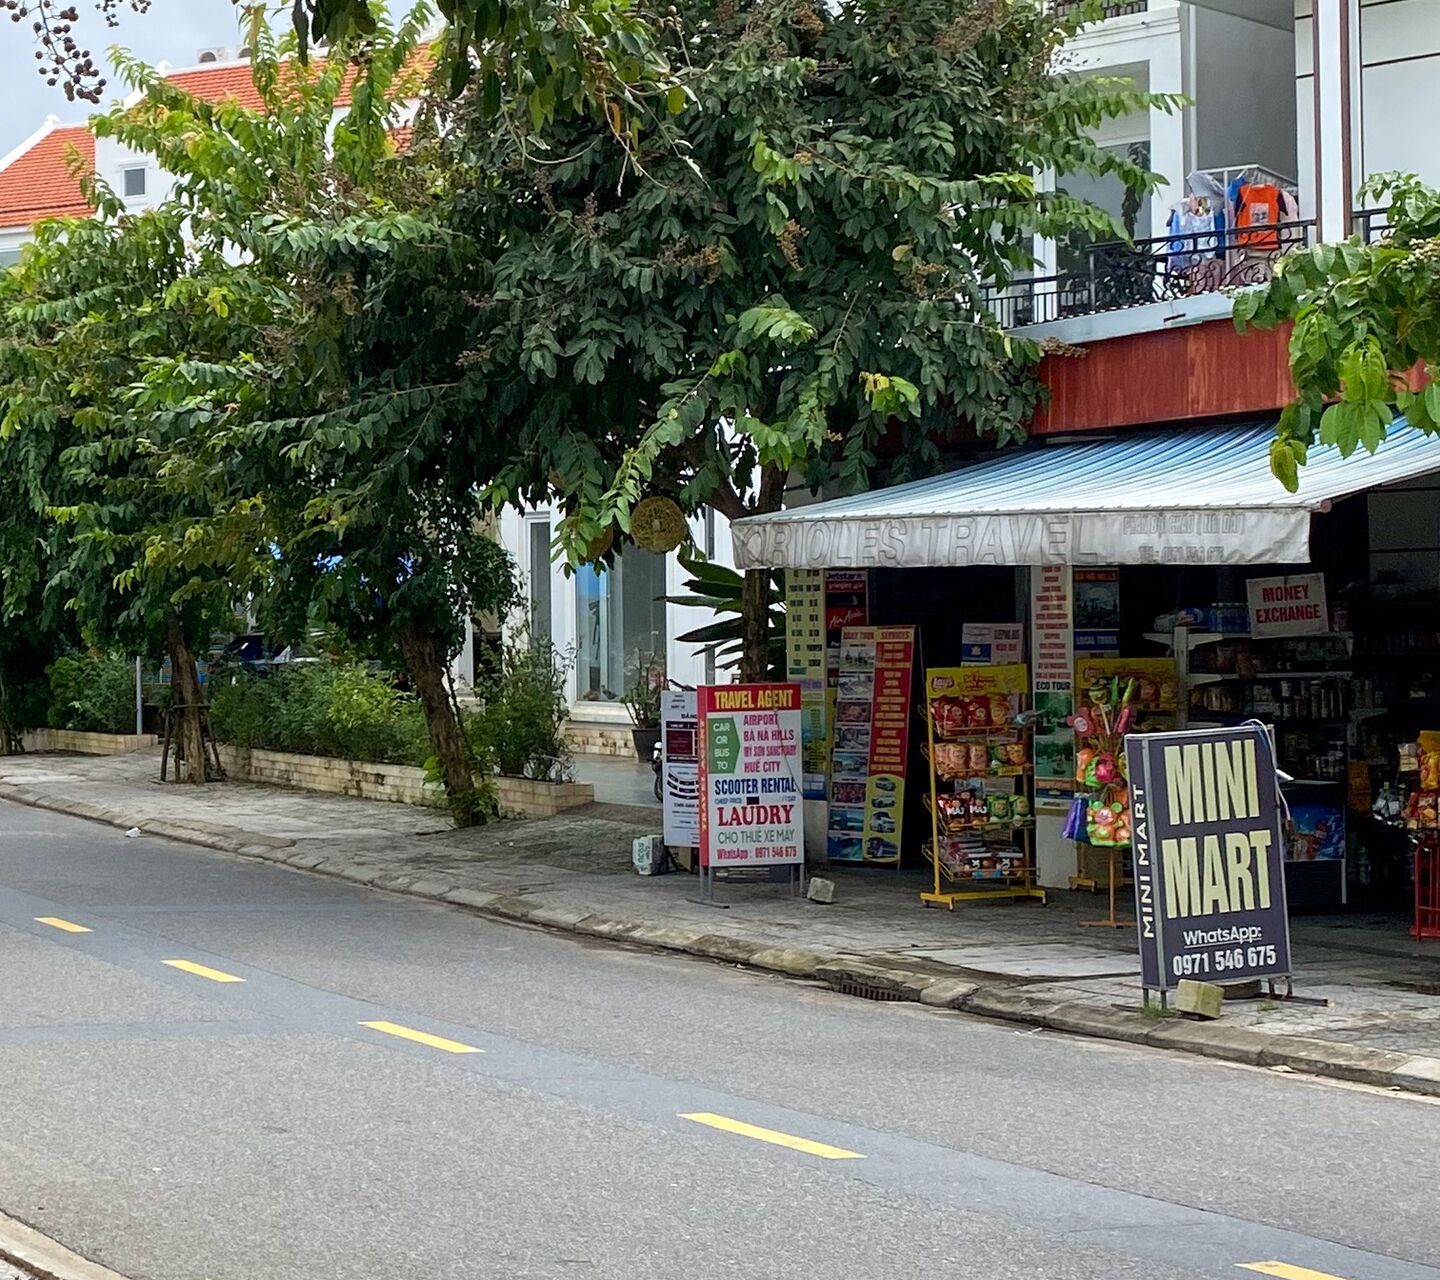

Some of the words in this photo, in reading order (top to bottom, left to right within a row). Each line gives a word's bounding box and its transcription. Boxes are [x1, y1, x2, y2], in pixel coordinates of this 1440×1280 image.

[742, 519, 908, 565] ORIOLES
[922, 515, 1098, 565] TRAVEL
[1262, 584, 1309, 602] MONEY
[1255, 603, 1321, 624] EXCHANGE
[1036, 681, 1051, 690] ECO
[1052, 681, 1071, 690] TOUR
[714, 690, 754, 710] TRAVEL
[757, 689, 793, 708] AGENT
[713, 723, 730, 733] CAR
[743, 713, 778, 726] AIRPORT
[715, 735, 728, 745] OR
[771, 728, 795, 741] HILLS
[714, 747, 730, 758] BUS
[716, 760, 728, 770] TO
[763, 761, 781, 773] CITY
[714, 779, 758, 795] SCOOTER
[761, 777, 797, 793] RENTAL
[1163, 739, 1260, 826] MINI
[716, 804, 795, 827] LAUDRY
[1133, 784, 1149, 866] MART
[717, 831, 738, 844] CHO
[764, 830, 775, 842] XE
[1162, 829, 1272, 919] MART
[1140, 875, 1154, 938] MINI
[1183, 926, 1262, 946] WhatsApp:
[1173, 952, 1210, 976] 0971
[1215, 948, 1244, 972] 546
[1247, 945, 1276, 968] 675
